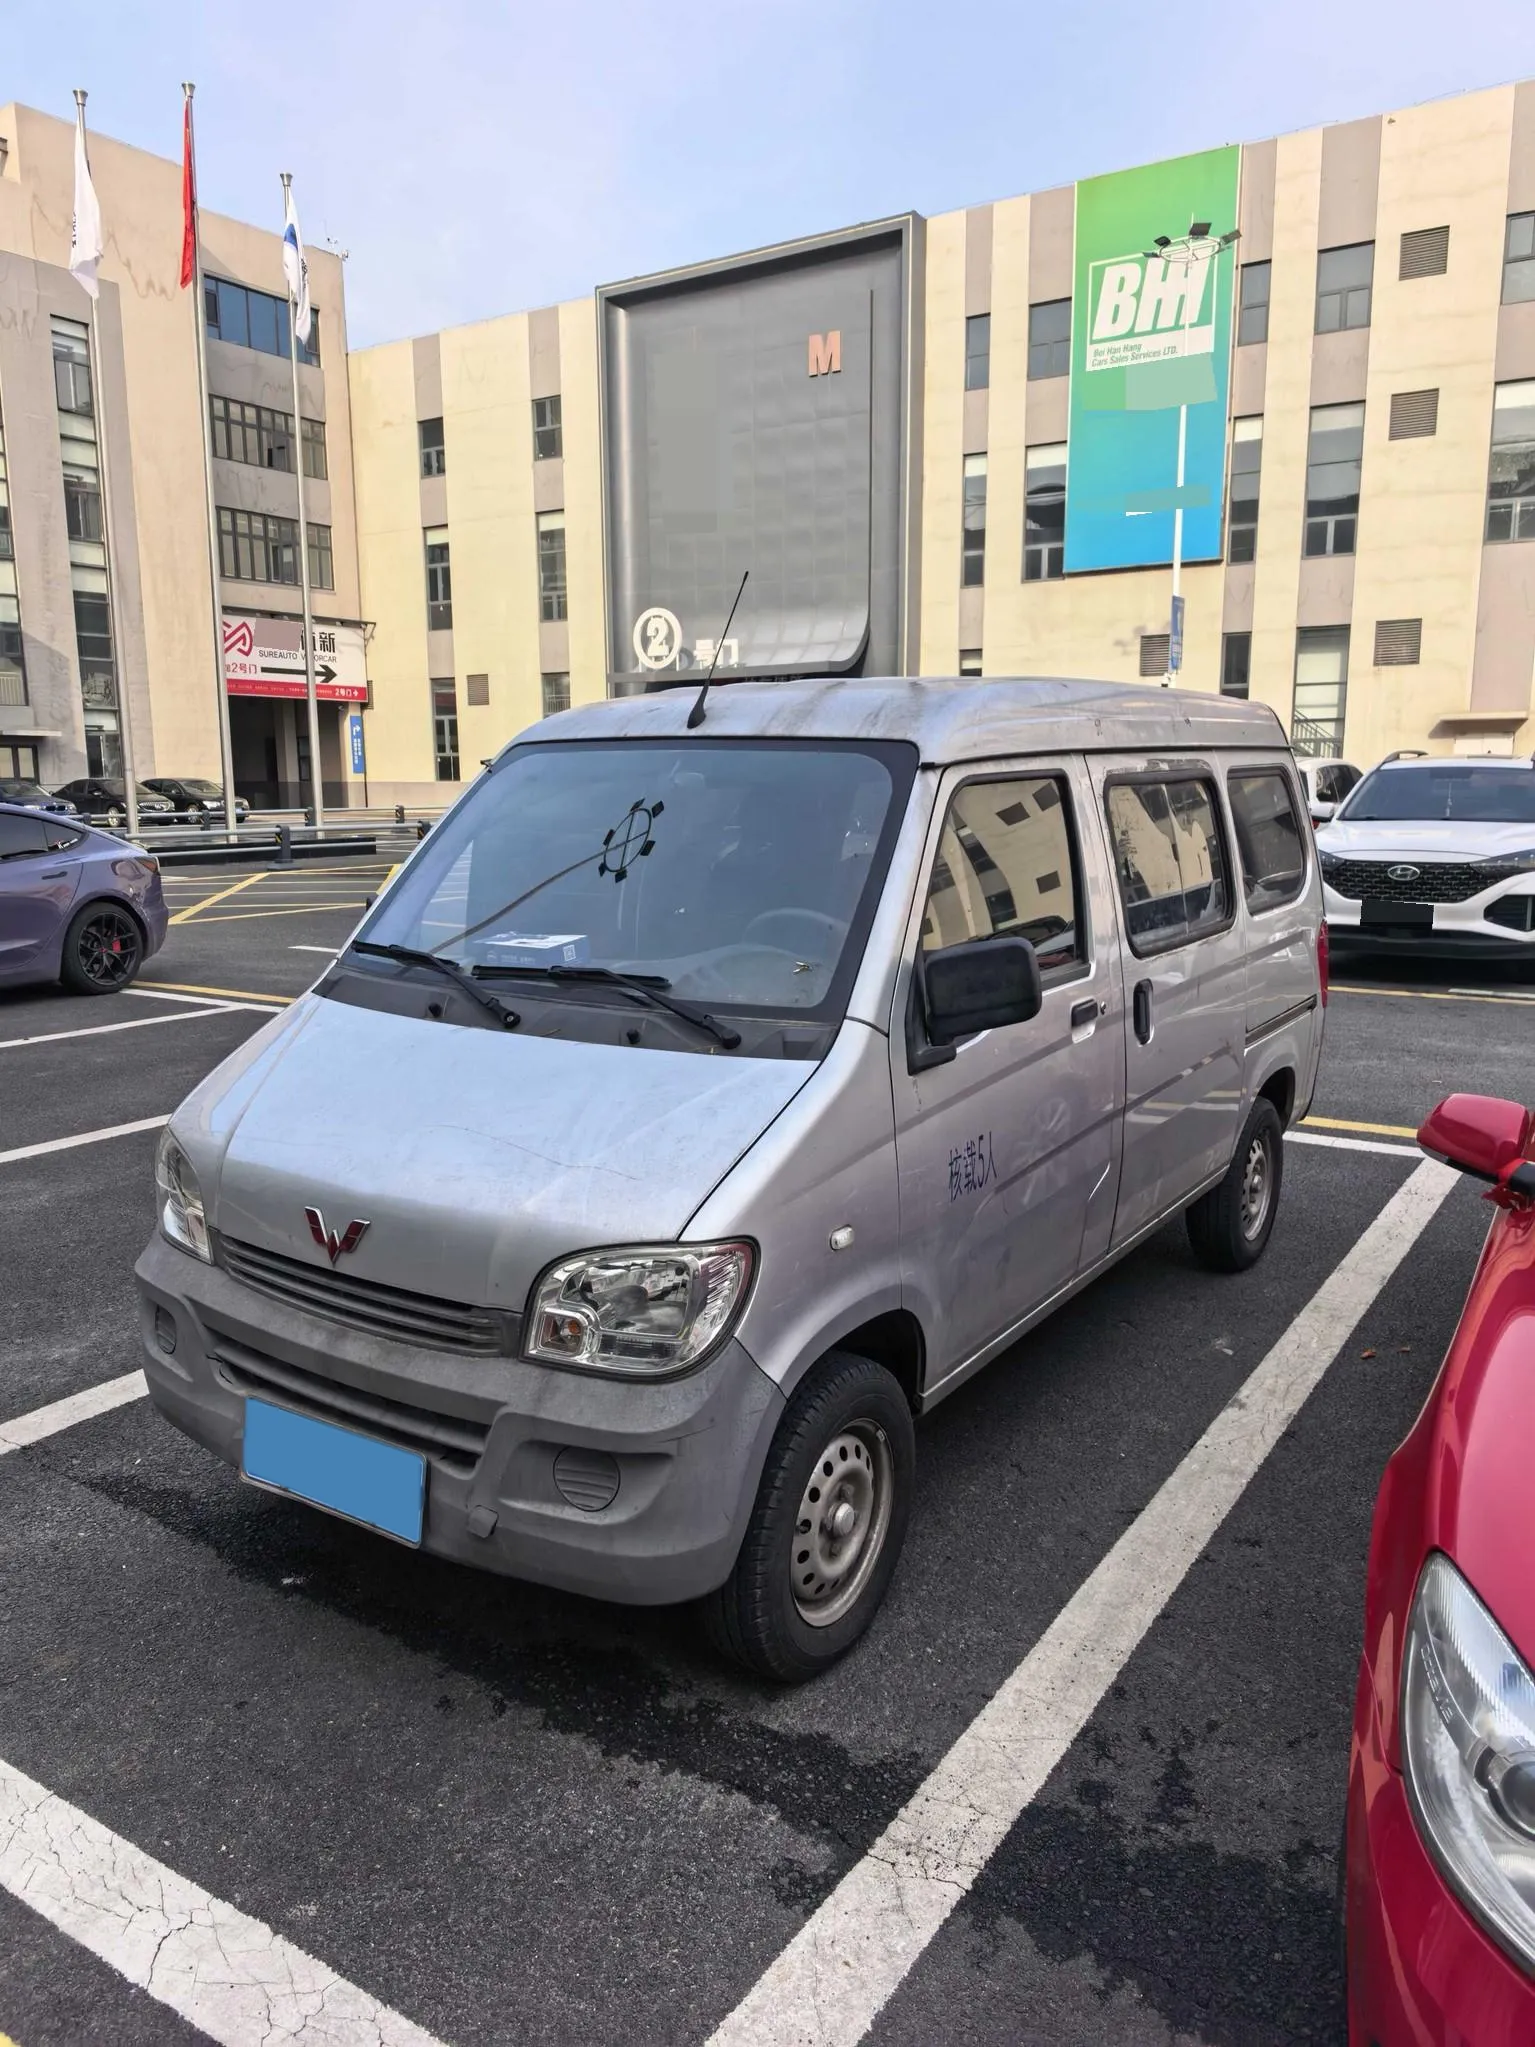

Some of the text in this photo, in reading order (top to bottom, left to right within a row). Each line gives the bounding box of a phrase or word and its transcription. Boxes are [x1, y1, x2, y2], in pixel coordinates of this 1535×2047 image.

[809, 331, 841, 376] M
[1107, 345, 1121, 354] Han
[1123, 343, 1143, 354] Hang
[1091, 358, 1108, 367] Cars
[1110, 355, 1129, 365] Sales
[1130, 349, 1161, 361] Services
[258, 650, 297, 660] SUREAUTO
